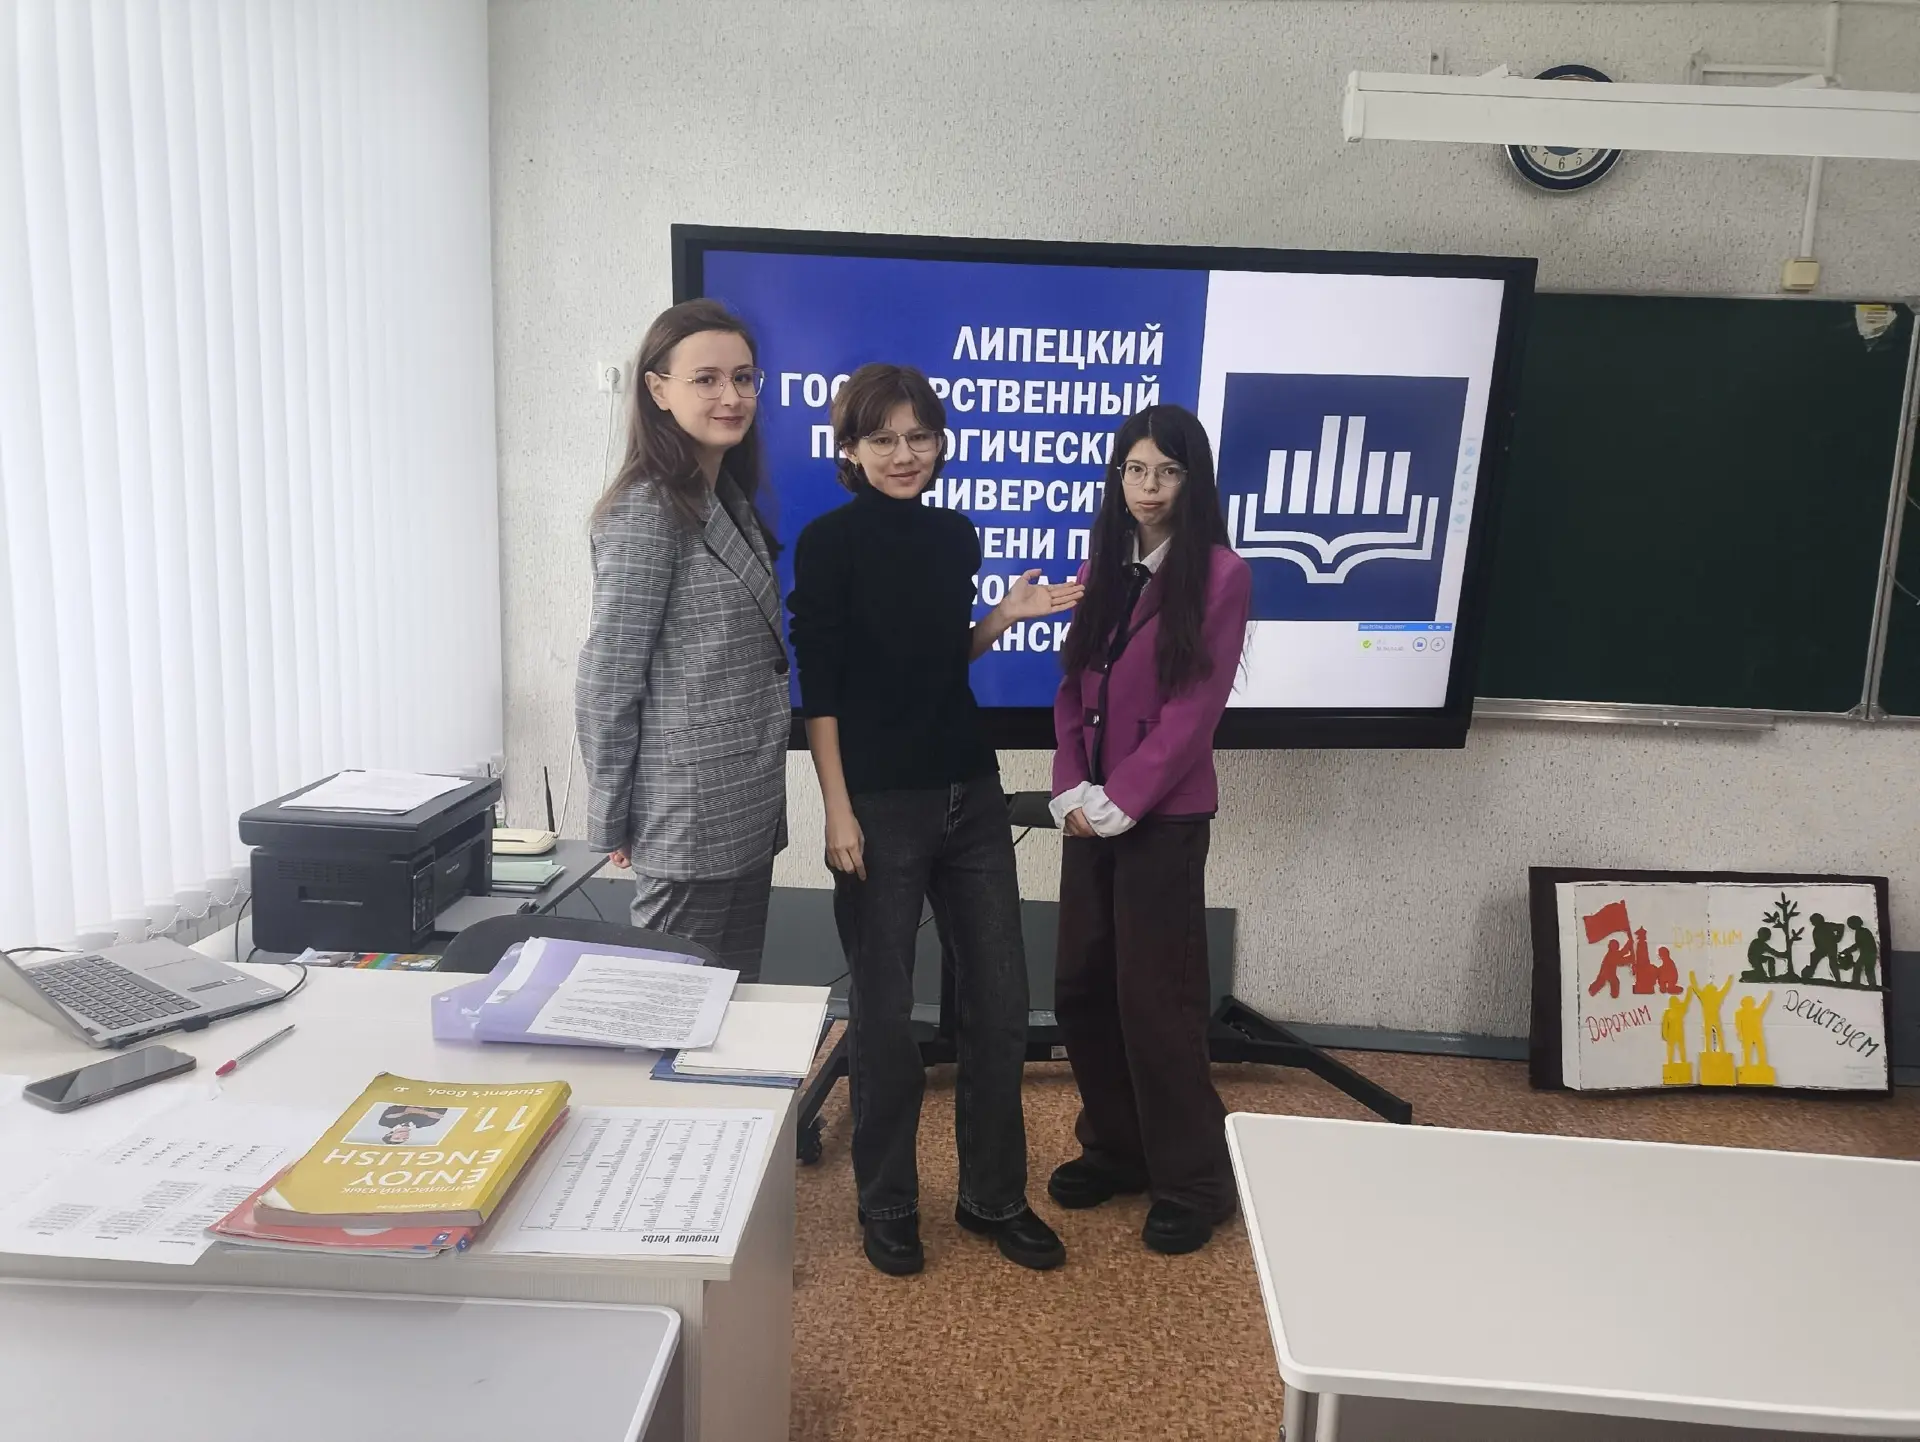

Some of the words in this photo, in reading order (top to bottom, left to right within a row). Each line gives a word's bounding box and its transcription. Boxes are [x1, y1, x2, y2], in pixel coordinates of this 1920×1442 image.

[1543, 152, 1548, 165] 7
[1559, 157, 1565, 170] 6
[1576, 153, 1582, 165] 5
[953, 323, 1164, 370] ЛИПЕЦКИЙ
[781, 373, 1160, 416] ГОРСТВЕННЫЙ
[975, 527, 1055, 559] ЕНИ
[1585, 1005, 1651, 1043] Дорожим
[1782, 989, 1880, 1057] Действуем
[426, 1088, 468, 1098] Book
[471, 1088, 544, 1098] Student's
[473, 1105, 528, 1133] 11
[323, 1148, 502, 1166] ENGLISH
[348, 1168, 488, 1186] ENJOY
[640, 1234, 671, 1244] Verbs
[674, 1234, 720, 1244] Irregular
